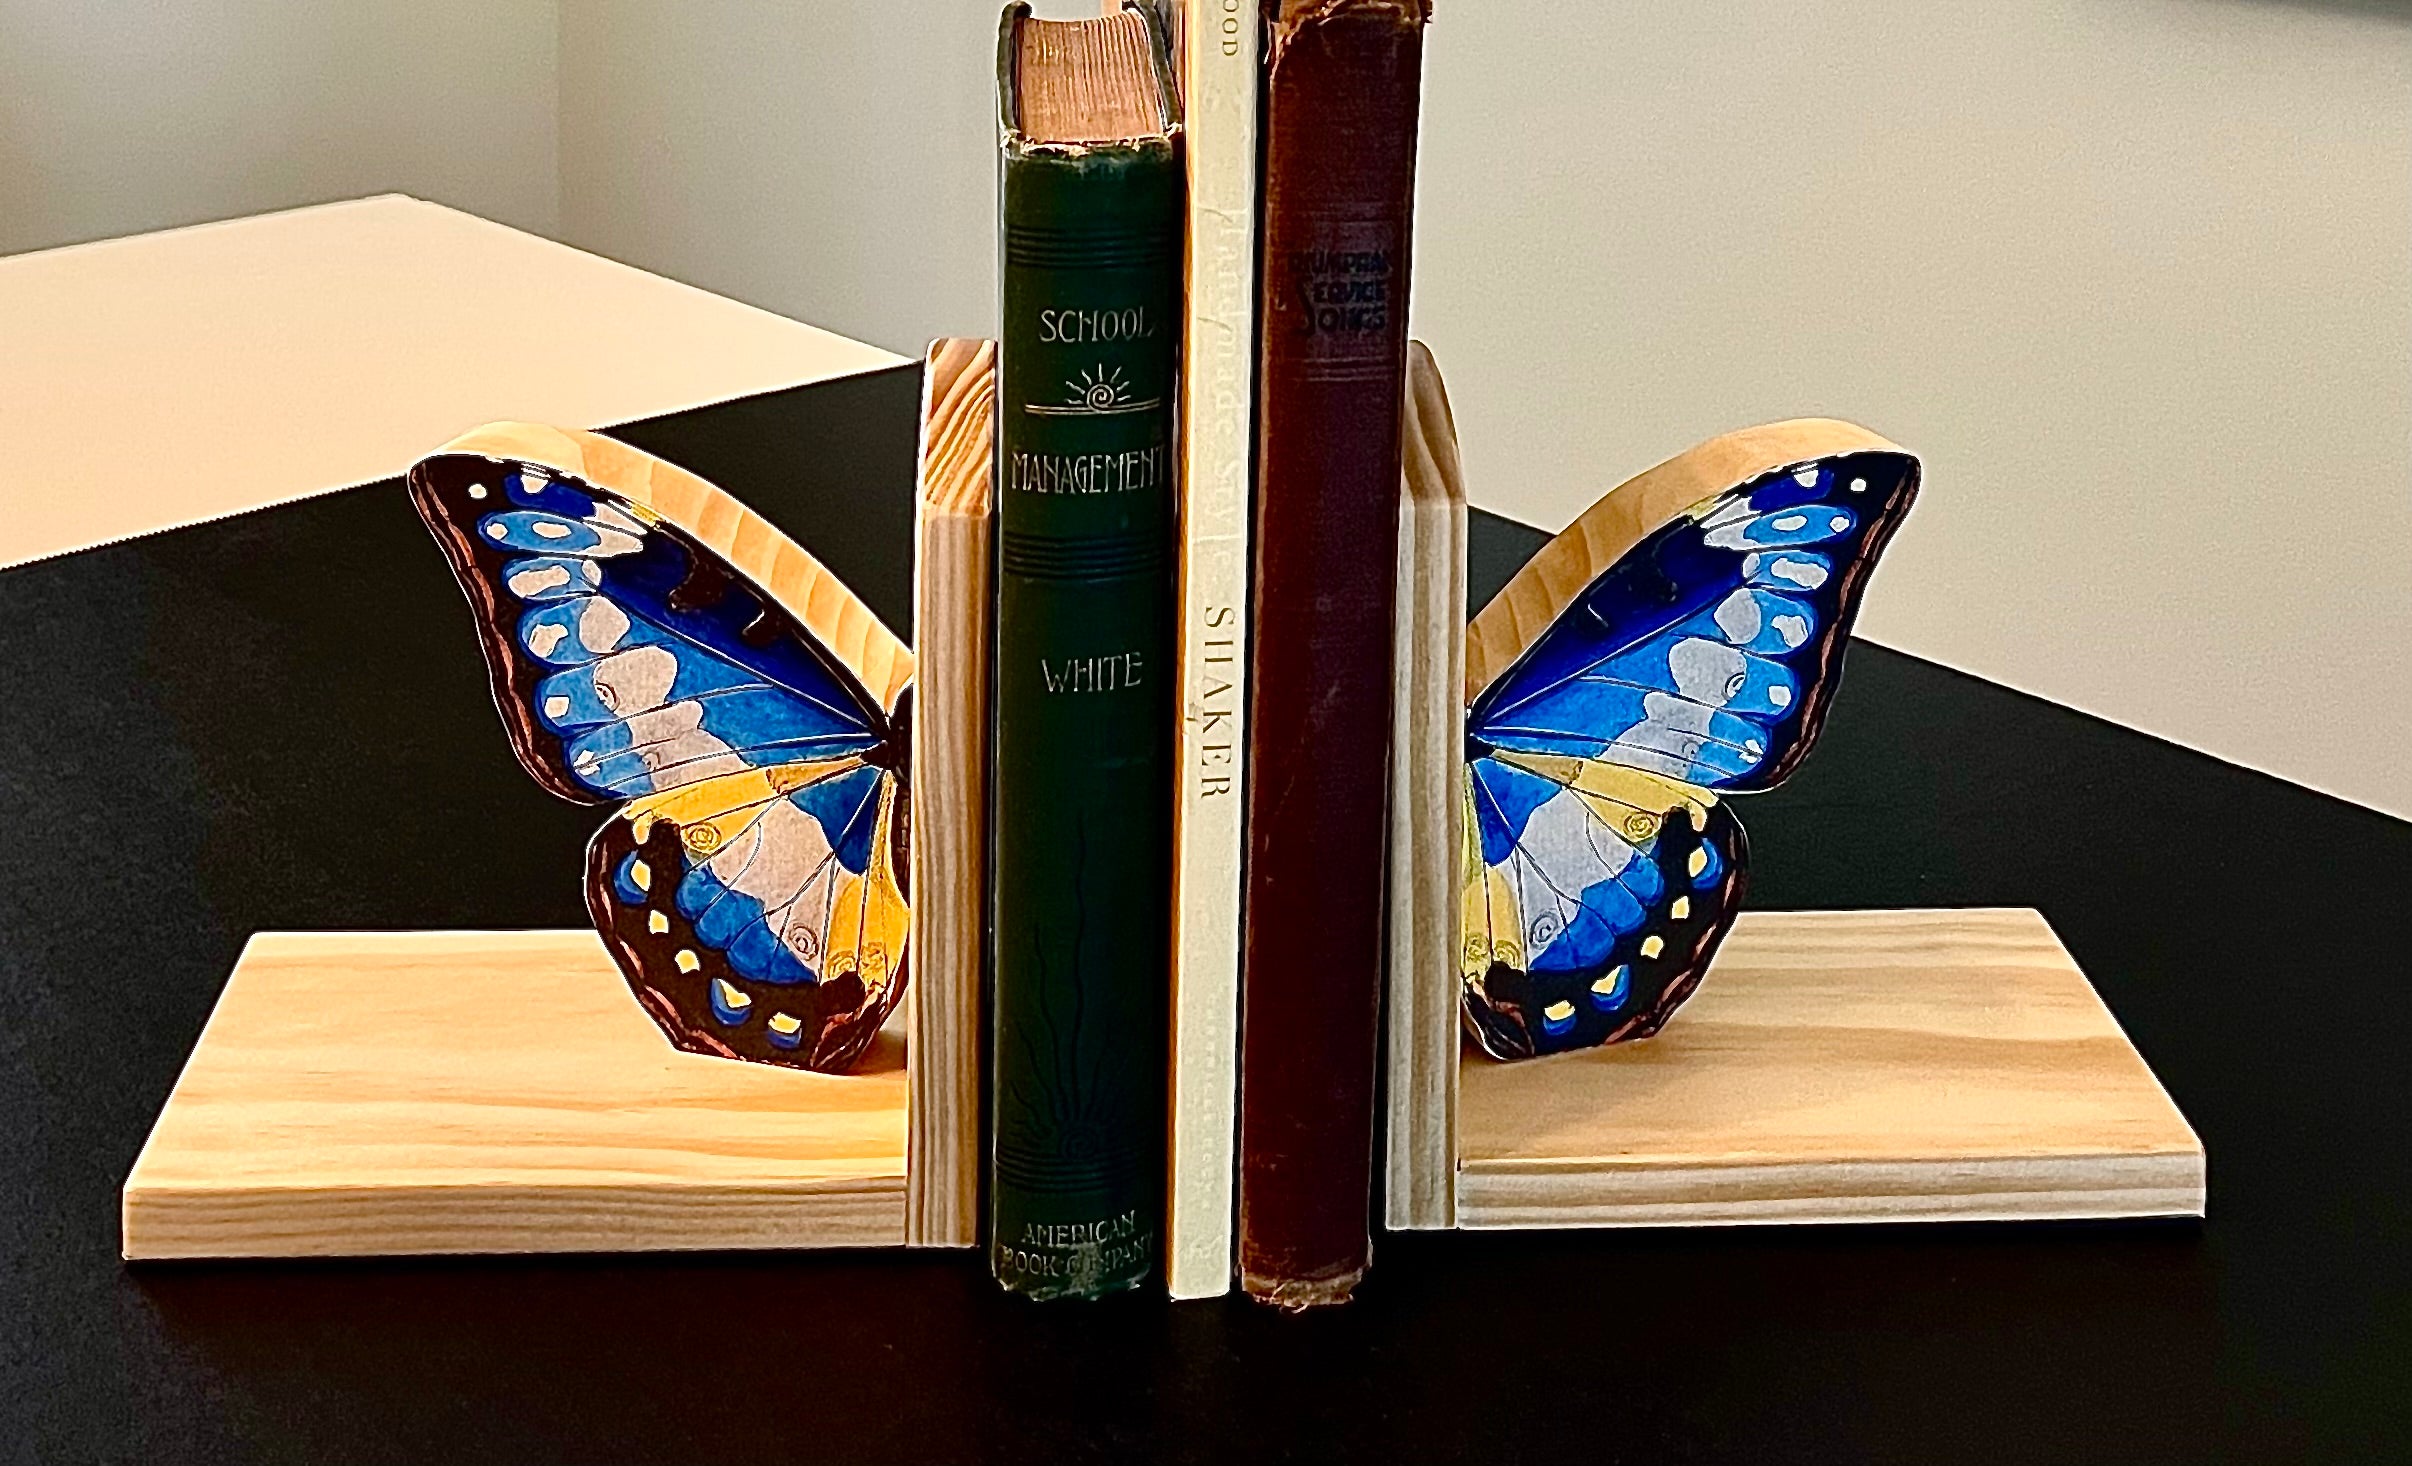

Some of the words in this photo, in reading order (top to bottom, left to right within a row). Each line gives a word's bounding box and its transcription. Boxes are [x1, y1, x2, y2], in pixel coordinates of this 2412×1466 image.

[1039, 306, 1155, 343] SCHOOL
[1010, 444, 1166, 494] MANAGEMENT
[1041, 651, 1143, 693] WHITE
[1201, 606, 1236, 799] SHAKER
[1020, 1209, 1136, 1249] AMERICAN
